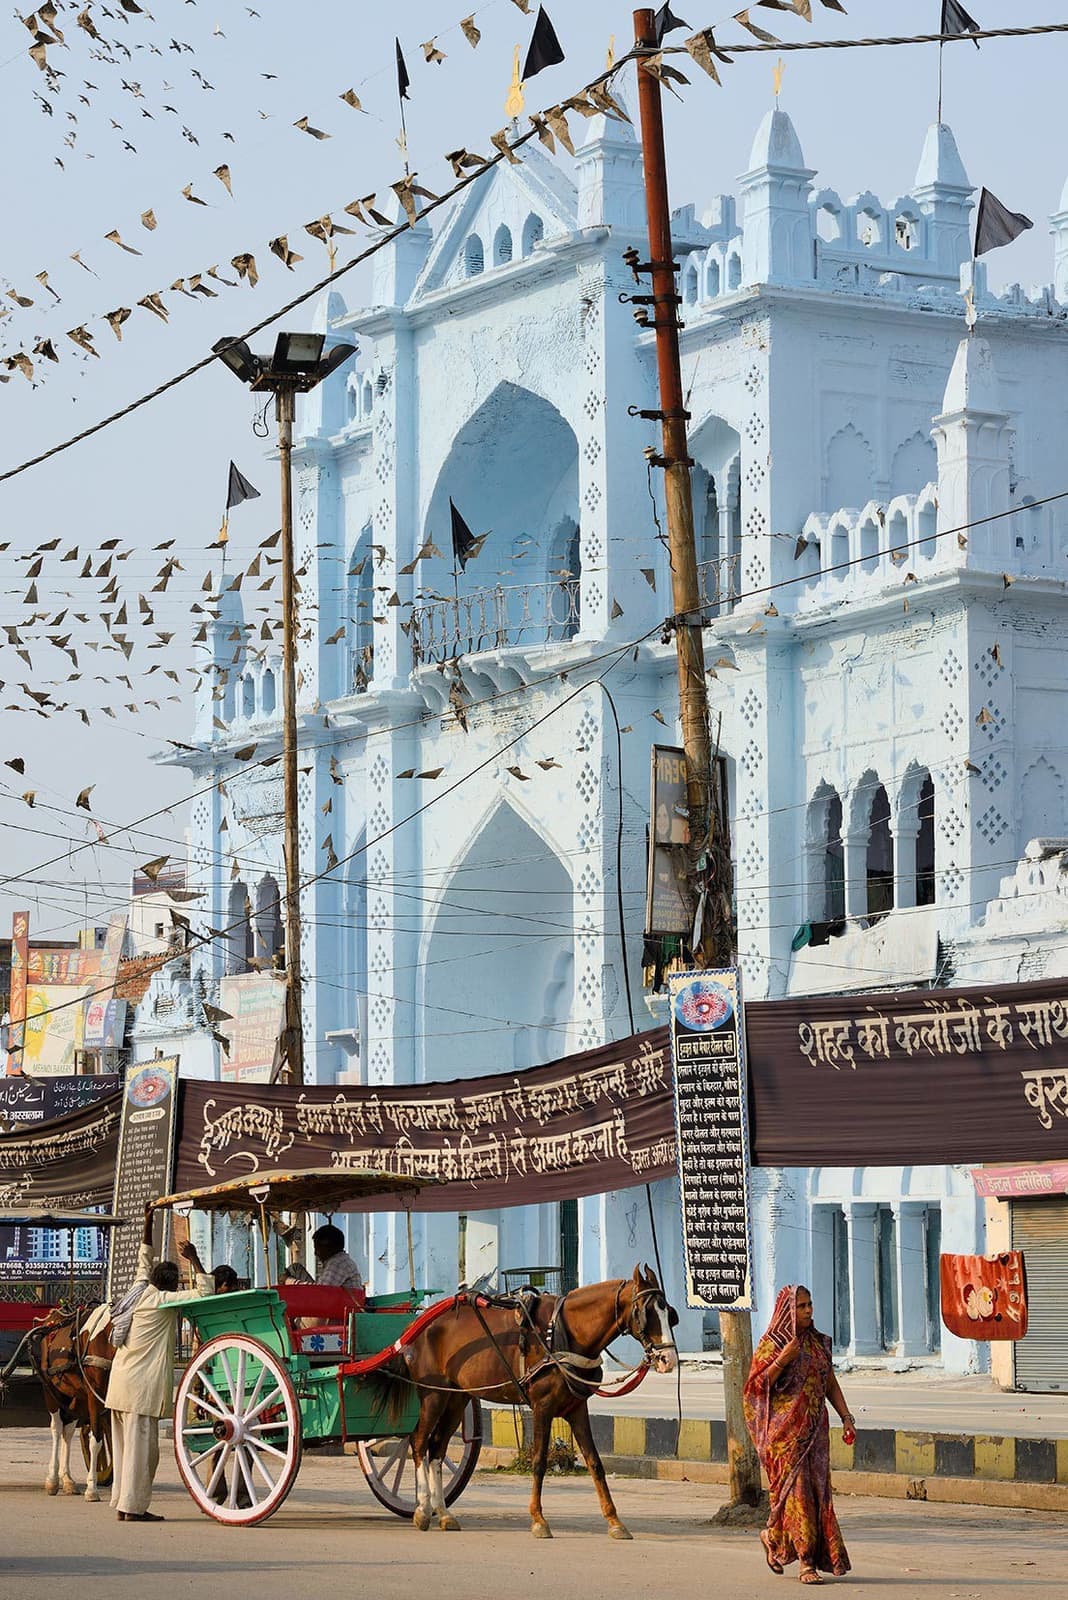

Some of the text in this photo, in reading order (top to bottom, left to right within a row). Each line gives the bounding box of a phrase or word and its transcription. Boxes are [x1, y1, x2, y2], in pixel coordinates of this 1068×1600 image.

[798, 1021, 857, 1071] शहद
[854, 1005, 890, 1059] को
[983, 996, 1014, 1050] के
[296, 1092, 333, 1142] ईमान
[333, 1092, 367, 1145] दिल
[365, 1093, 384, 1134] से
[503, 1078, 527, 1123] से
[578, 1063, 630, 1105] करना
[631, 1041, 668, 1098] और
[692, 1094, 704, 1109] और
[709, 1124, 720, 1139] और
[510, 1127, 528, 1178] से
[529, 1136, 572, 1174] अमल
[571, 1120, 615, 1163] करना
[613, 1108, 632, 1166] है
[717, 1140, 726, 1153] और
[699, 1157, 706, 1170] तो
[711, 1202, 722, 1217] और
[711, 1233, 722, 1248] और
